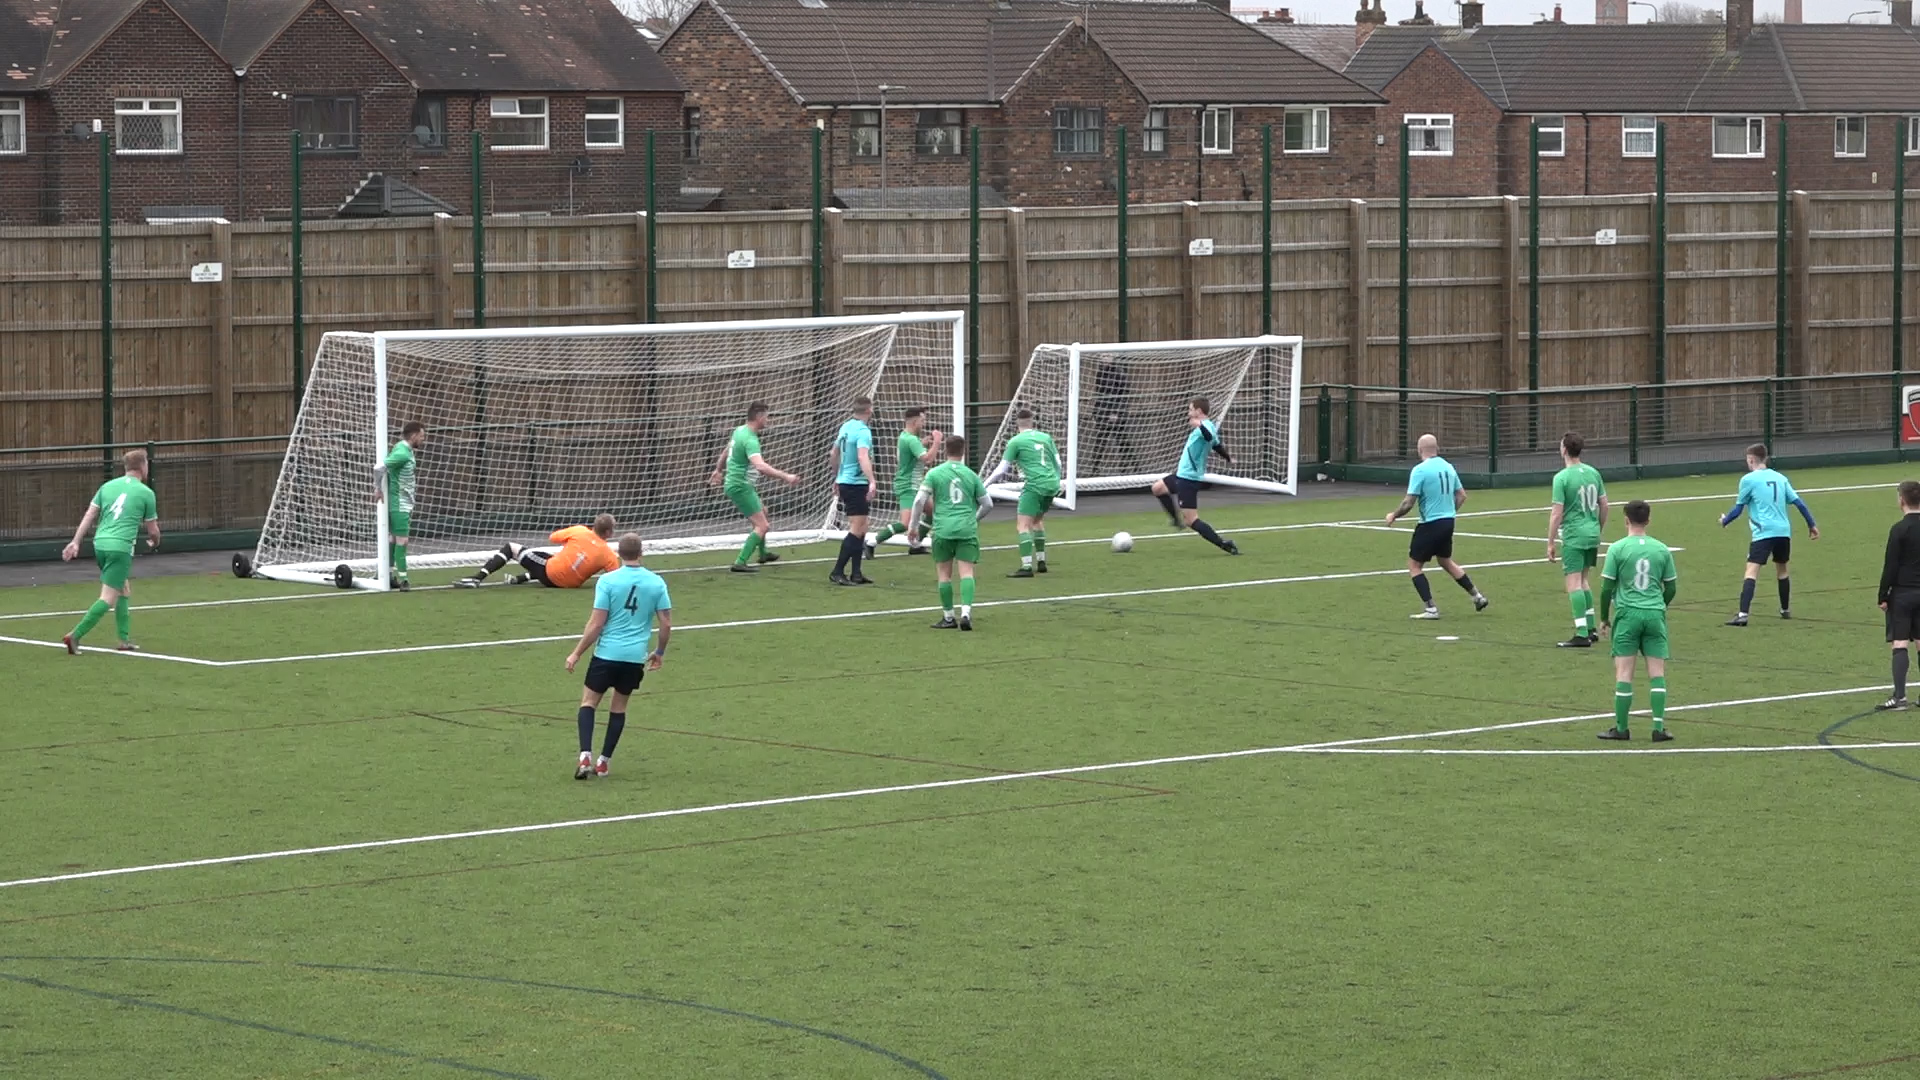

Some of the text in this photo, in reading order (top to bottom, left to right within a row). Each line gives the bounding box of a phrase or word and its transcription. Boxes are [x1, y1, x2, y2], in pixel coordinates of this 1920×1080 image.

[1034, 443, 1046, 466] 7
[950, 478, 963, 504] 6
[1438, 471, 1450, 495] 11
[1766, 481, 1777, 502] 7
[109, 493, 127, 520] 4
[1577, 484, 1598, 512] 10
[1634, 558, 1650, 590] 8
[624, 585, 638, 616] 4
